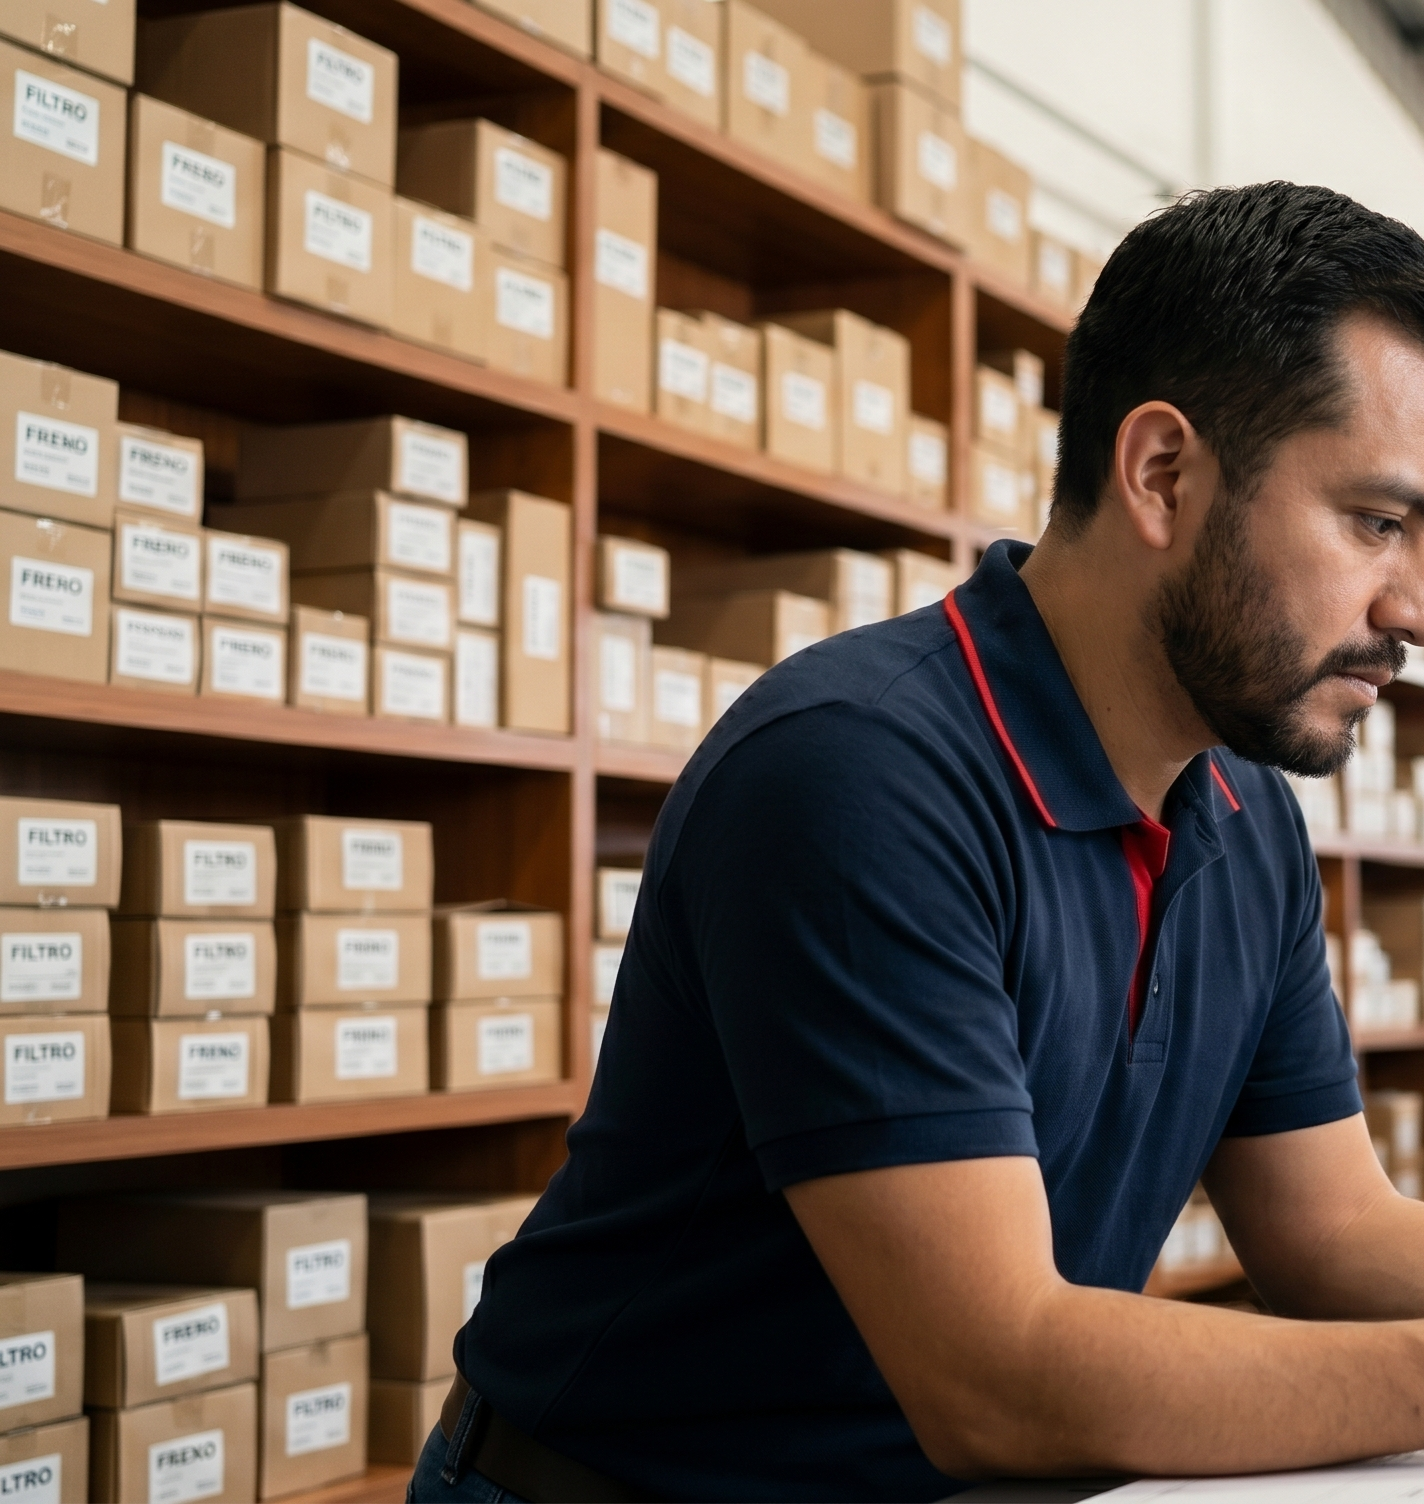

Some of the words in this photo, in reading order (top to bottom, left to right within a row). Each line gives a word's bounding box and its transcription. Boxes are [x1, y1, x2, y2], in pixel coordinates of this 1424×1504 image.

[26, 82, 88, 123] FILTRO
[27, 827, 88, 848] FILTRO
[193, 850, 248, 871] FILTRO
[11, 943, 72, 963] FILTRO
[193, 941, 248, 961] FILTRO
[13, 1042, 76, 1064] FILTRO
